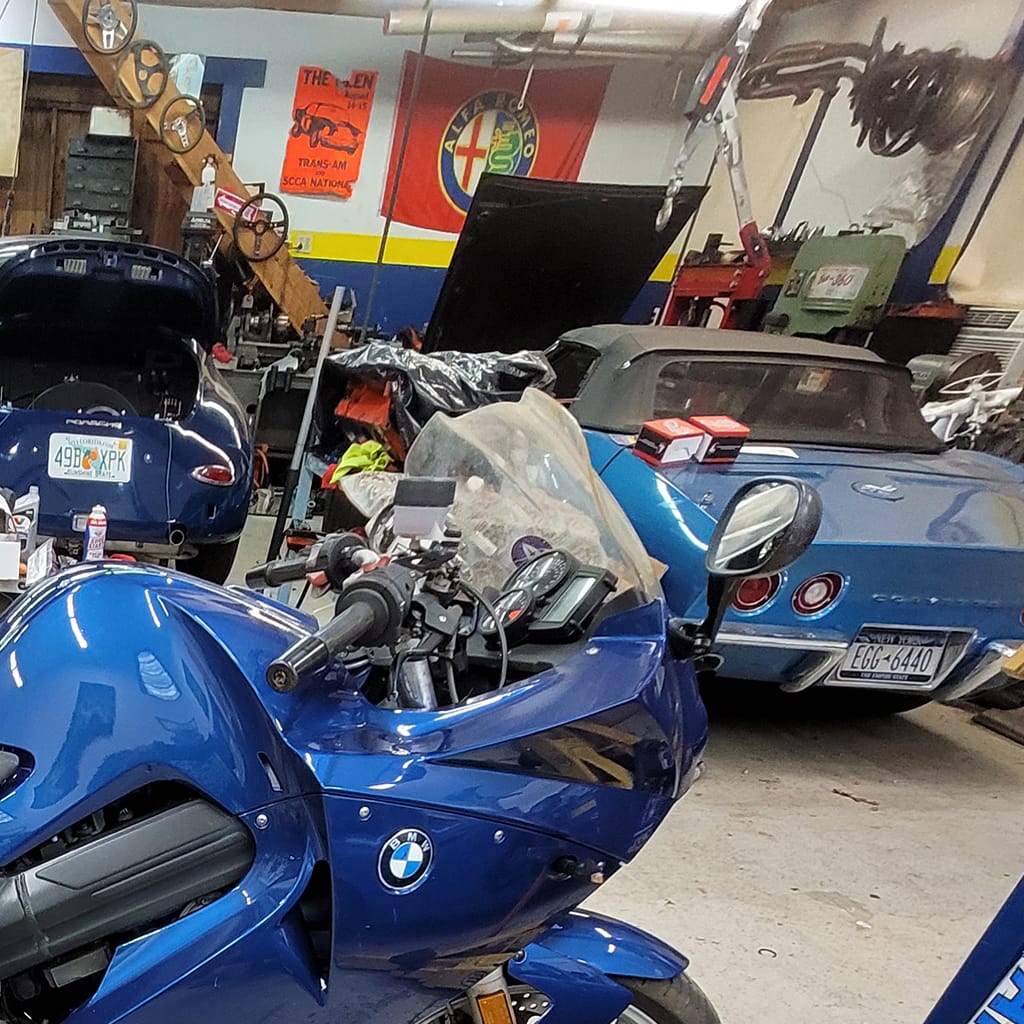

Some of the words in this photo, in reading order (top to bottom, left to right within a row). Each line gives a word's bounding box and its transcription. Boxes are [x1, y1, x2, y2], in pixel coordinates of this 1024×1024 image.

[303, 69, 332, 86] THE
[444, 100, 484, 153] ALFA
[298, 158, 347, 170] TRANS-AM
[282, 175, 307, 186] SCCA
[100, 449, 126, 472] XPK
[851, 645, 884, 669] EGG
[890, 648, 934, 672] 6440
[389, 832, 431, 852] BMW
